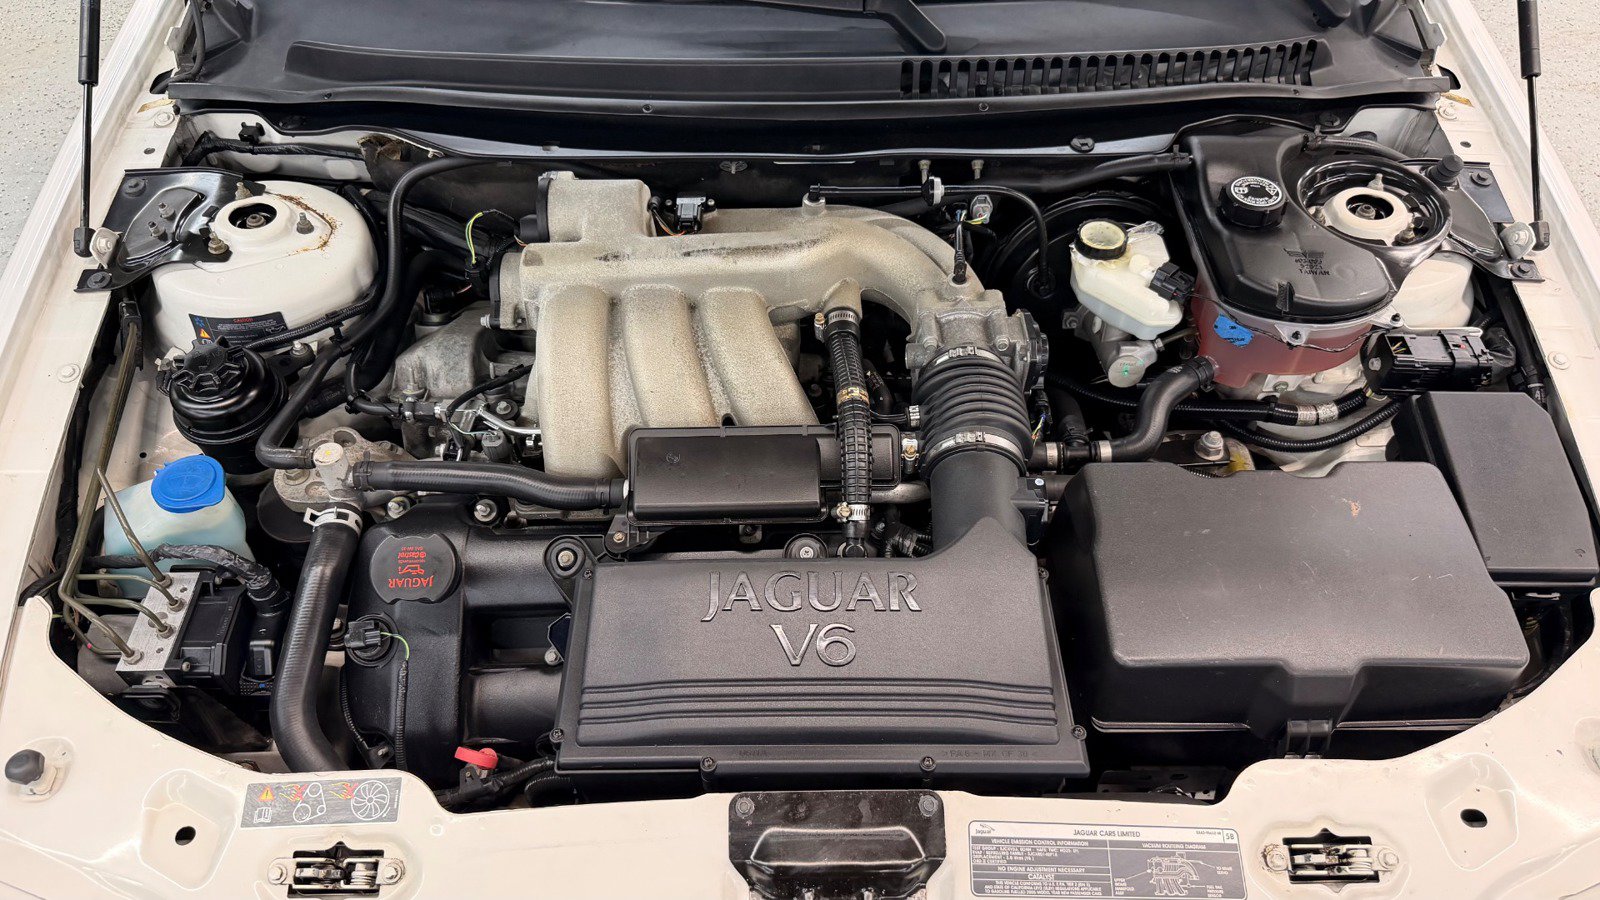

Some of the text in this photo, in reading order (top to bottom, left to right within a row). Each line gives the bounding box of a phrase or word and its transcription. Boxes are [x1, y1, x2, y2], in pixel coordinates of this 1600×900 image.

[388, 575, 434, 588] JAGUAR
[700, 570, 922, 622] JAGUAR
[769, 622, 857, 667] V6
[1117, 830, 1141, 838] LIMITED
